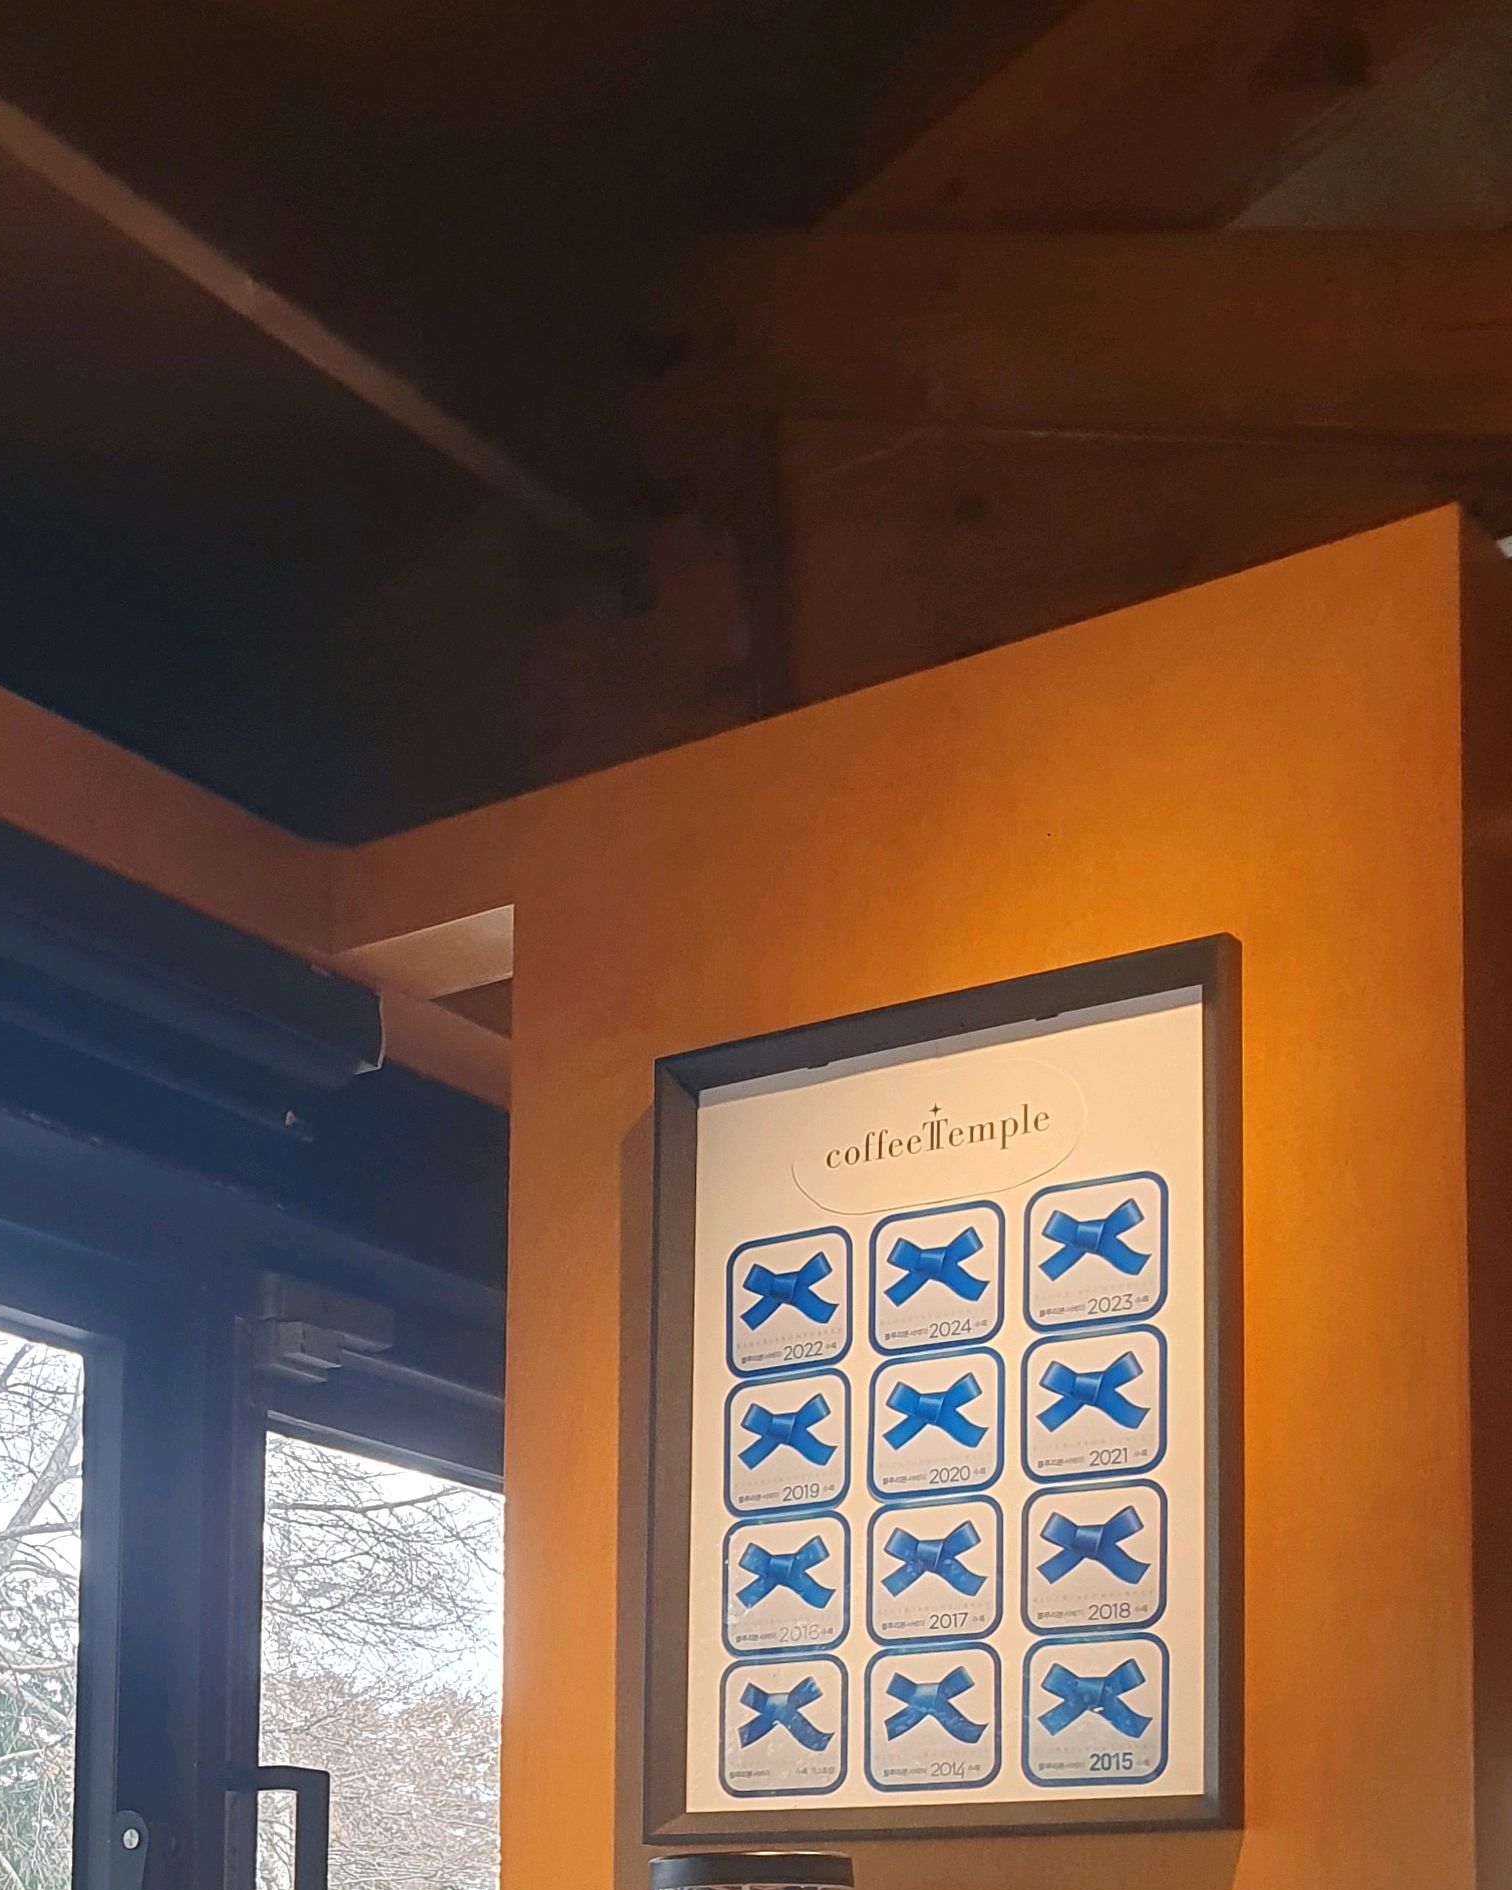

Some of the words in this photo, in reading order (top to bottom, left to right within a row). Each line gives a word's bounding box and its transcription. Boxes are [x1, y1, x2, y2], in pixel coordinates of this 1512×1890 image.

[1088, 1293, 1133, 1315] 2023
[929, 1318, 972, 1339] 2024
[783, 1340, 823, 1361] 2022
[1089, 1447, 1129, 1468] 2021
[928, 1464, 971, 1485] 2020
[782, 1482, 821, 1503] 2019
[929, 1611, 969, 1631] 2017
[1088, 1601, 1131, 1621] 2018
[779, 1622, 820, 1644] 2016
[930, 1761, 966, 1780] 2014
[1089, 1752, 1134, 1772] 2015
